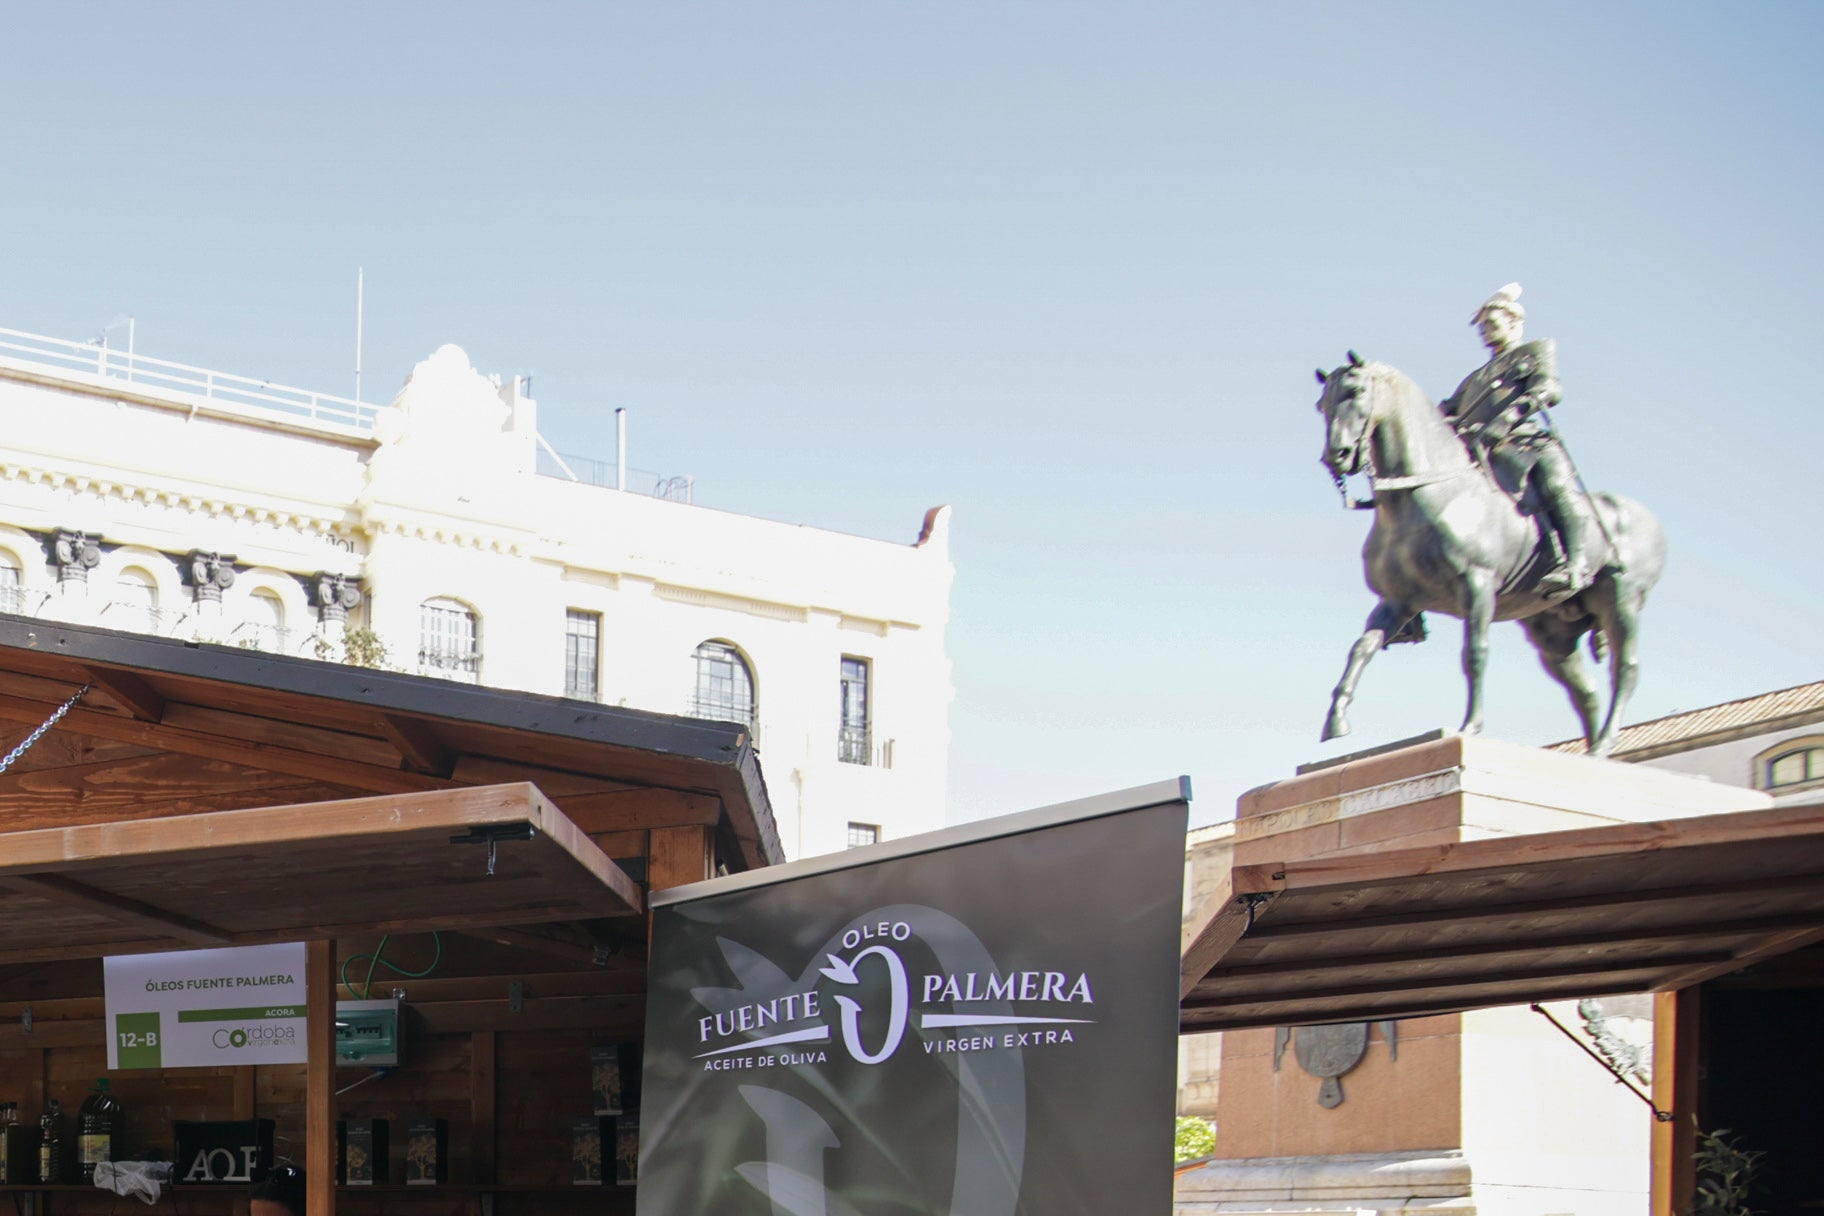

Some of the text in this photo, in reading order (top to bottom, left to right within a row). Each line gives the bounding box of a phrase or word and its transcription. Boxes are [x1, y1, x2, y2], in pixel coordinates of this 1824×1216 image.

[841, 921, 912, 950] OLEO
[145, 974, 294, 992] ÓLEOS FUENTE PALMERA
[265, 1008, 295, 1017] ACORA
[697, 971, 1094, 1043] FUENTE PALMERA
[119, 1032, 158, 1048] 12-B
[923, 1029, 1074, 1055] VIRGEN EXTRA
[703, 1051, 827, 1072] ACEITE DE OLIVA
